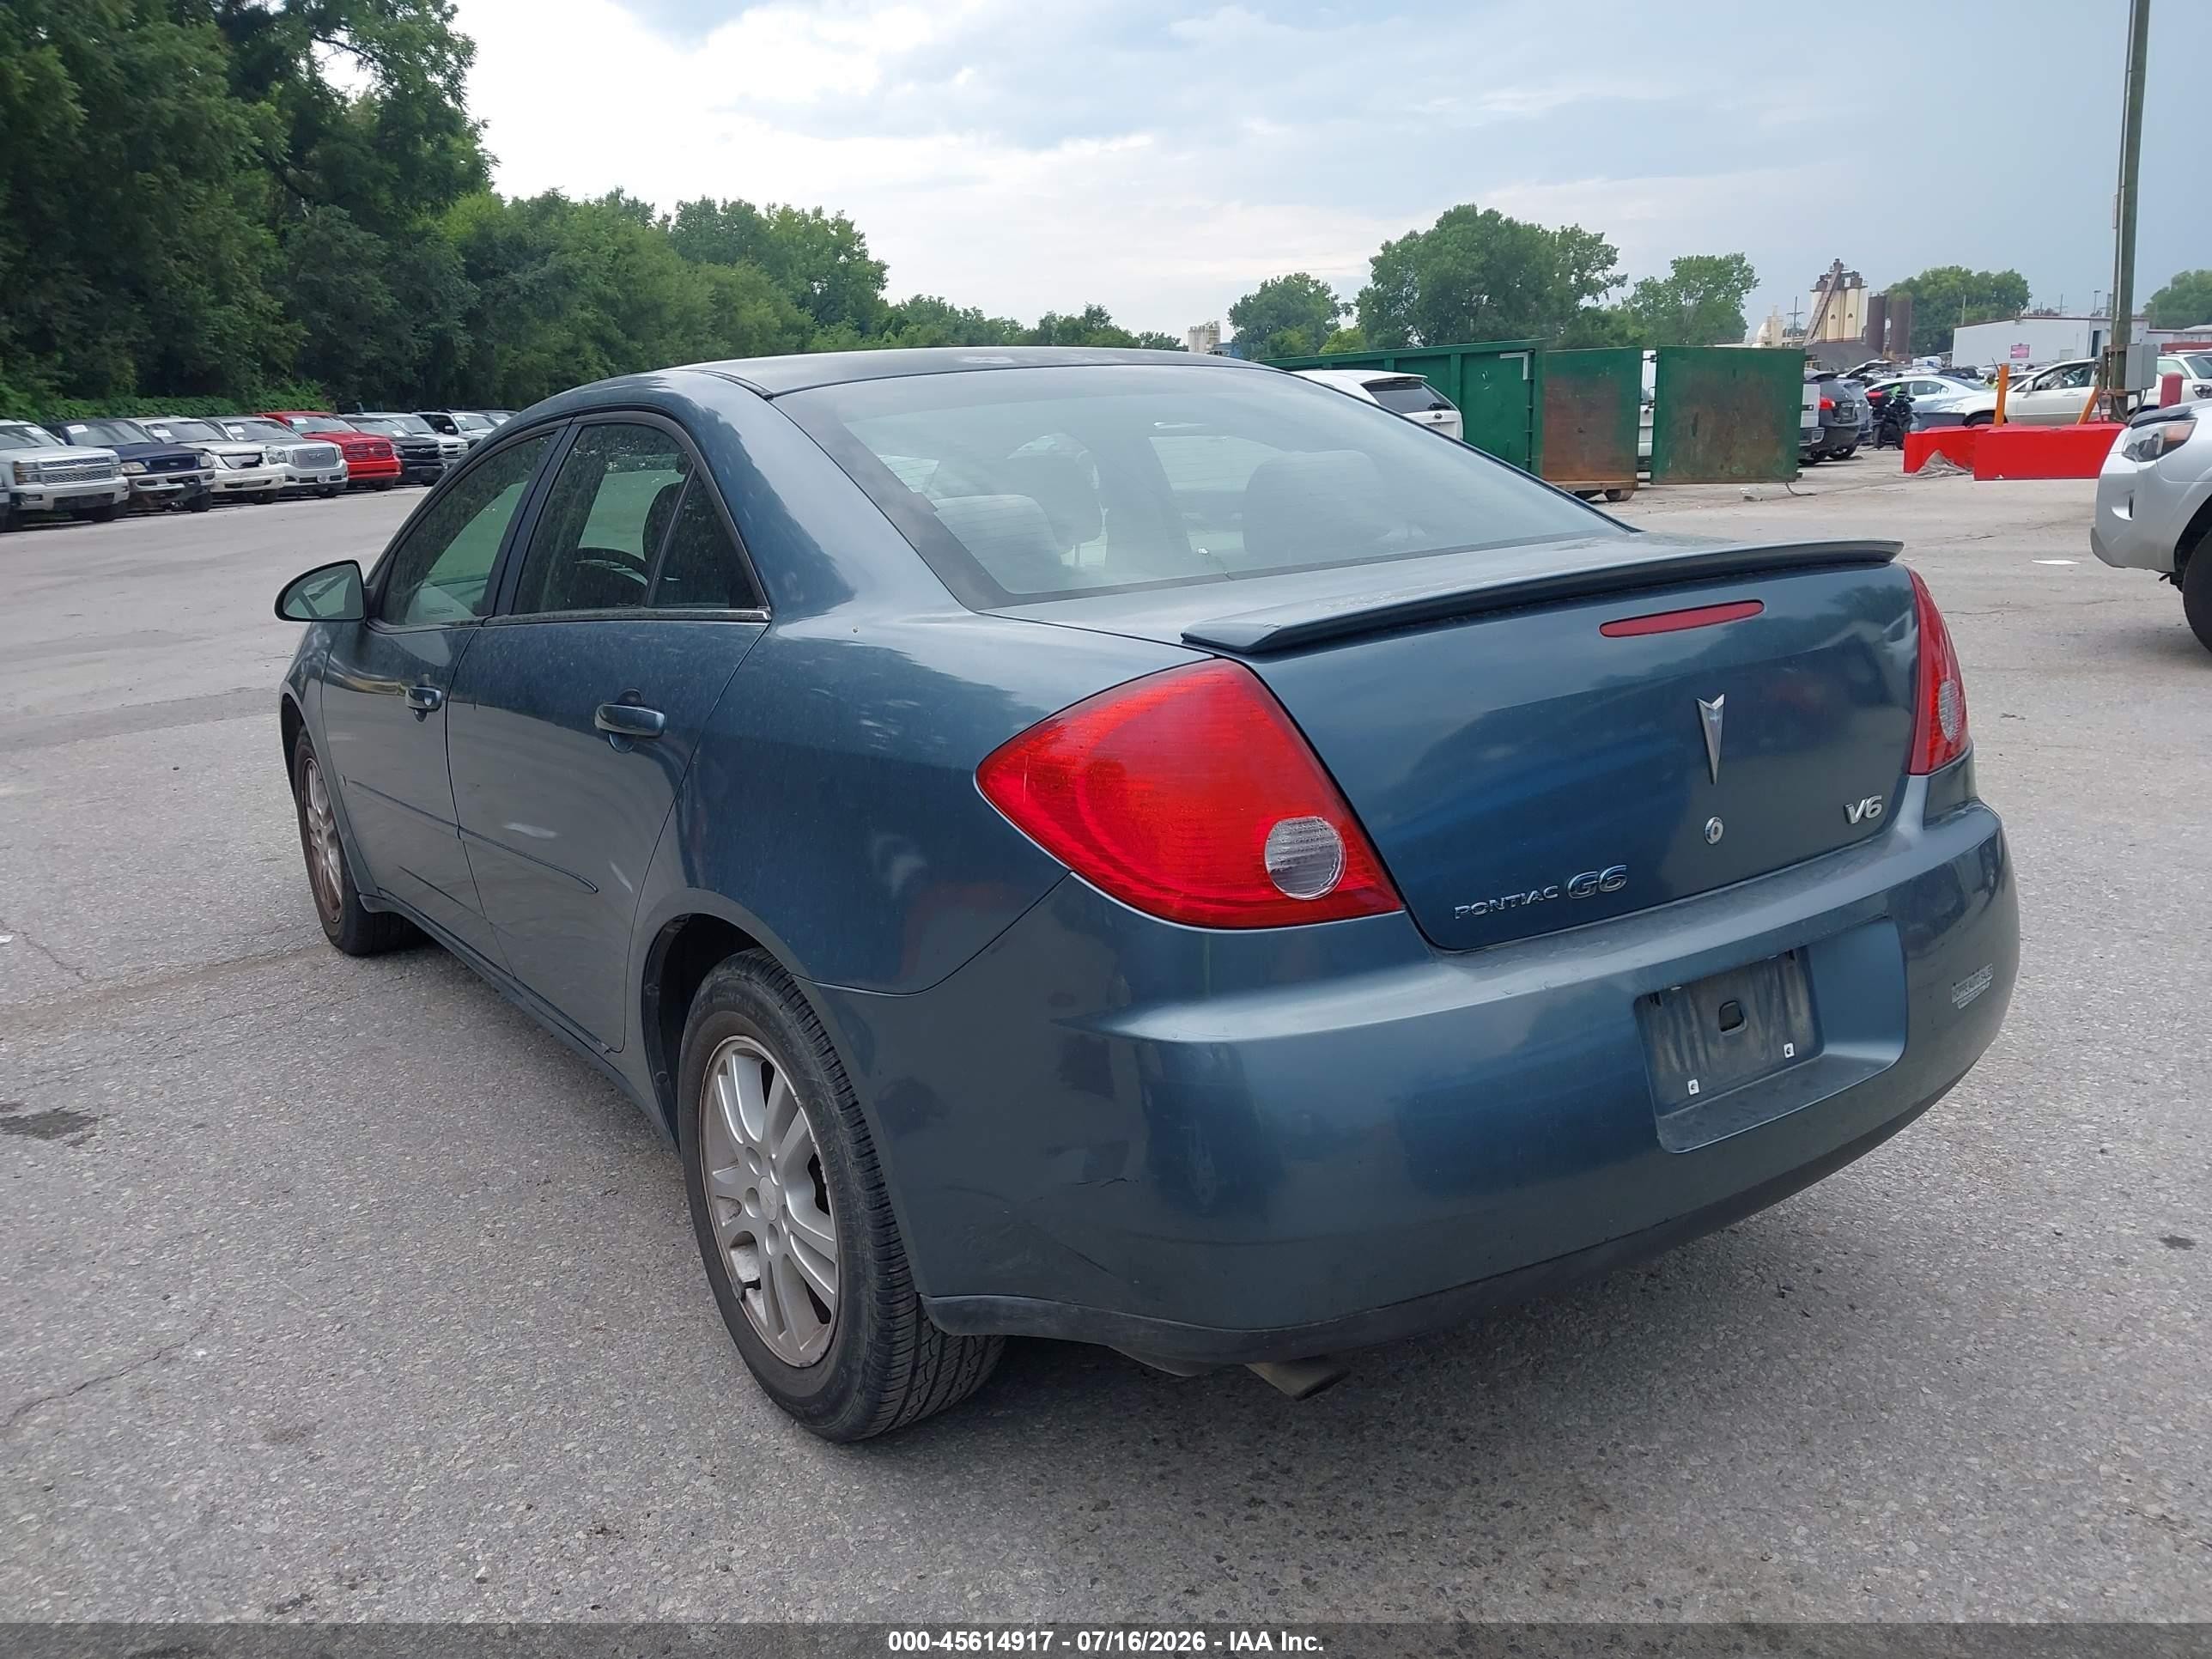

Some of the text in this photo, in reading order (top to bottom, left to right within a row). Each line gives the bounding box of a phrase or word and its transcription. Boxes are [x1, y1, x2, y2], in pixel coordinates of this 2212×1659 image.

[1843, 795, 1882, 824] V6
[1454, 864, 1627, 920] PONTIAC G6
